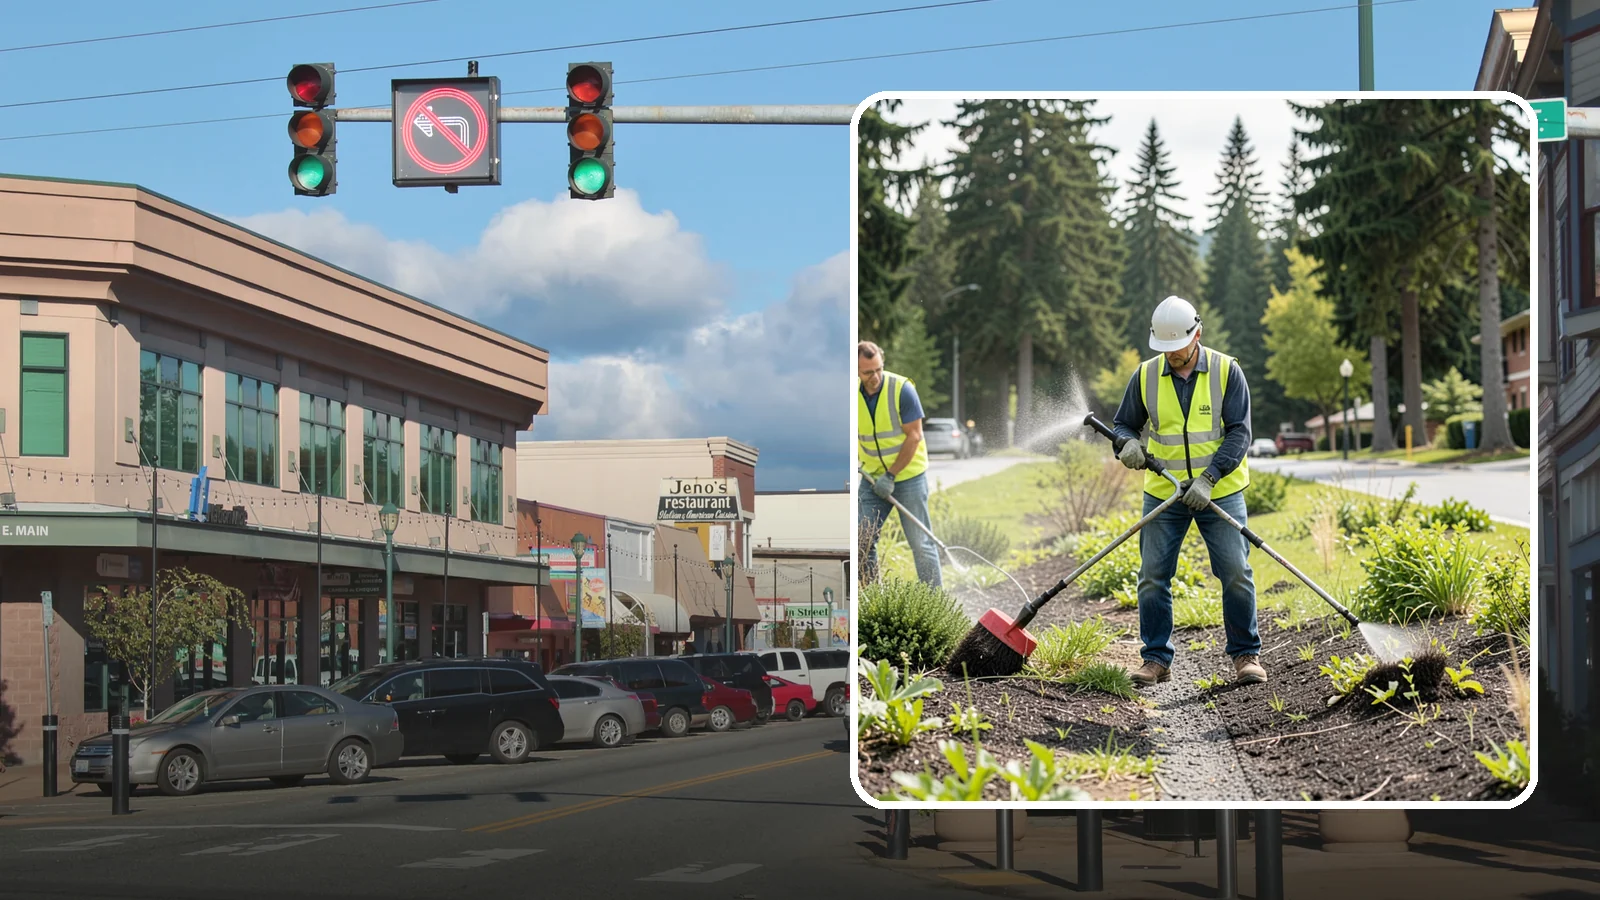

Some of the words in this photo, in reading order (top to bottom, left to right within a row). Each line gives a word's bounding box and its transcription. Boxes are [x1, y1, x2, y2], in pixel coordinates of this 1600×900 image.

[669, 479, 728, 495] Jeno's
[665, 496, 731, 509] restaurant
[658, 510, 681, 520] Italian
[686, 510, 714, 520] American
[715, 510, 737, 520] Cuisine
[2, 525, 13, 536] E.
[15, 525, 49, 536] MAIN
[797, 607, 828, 616] Street
